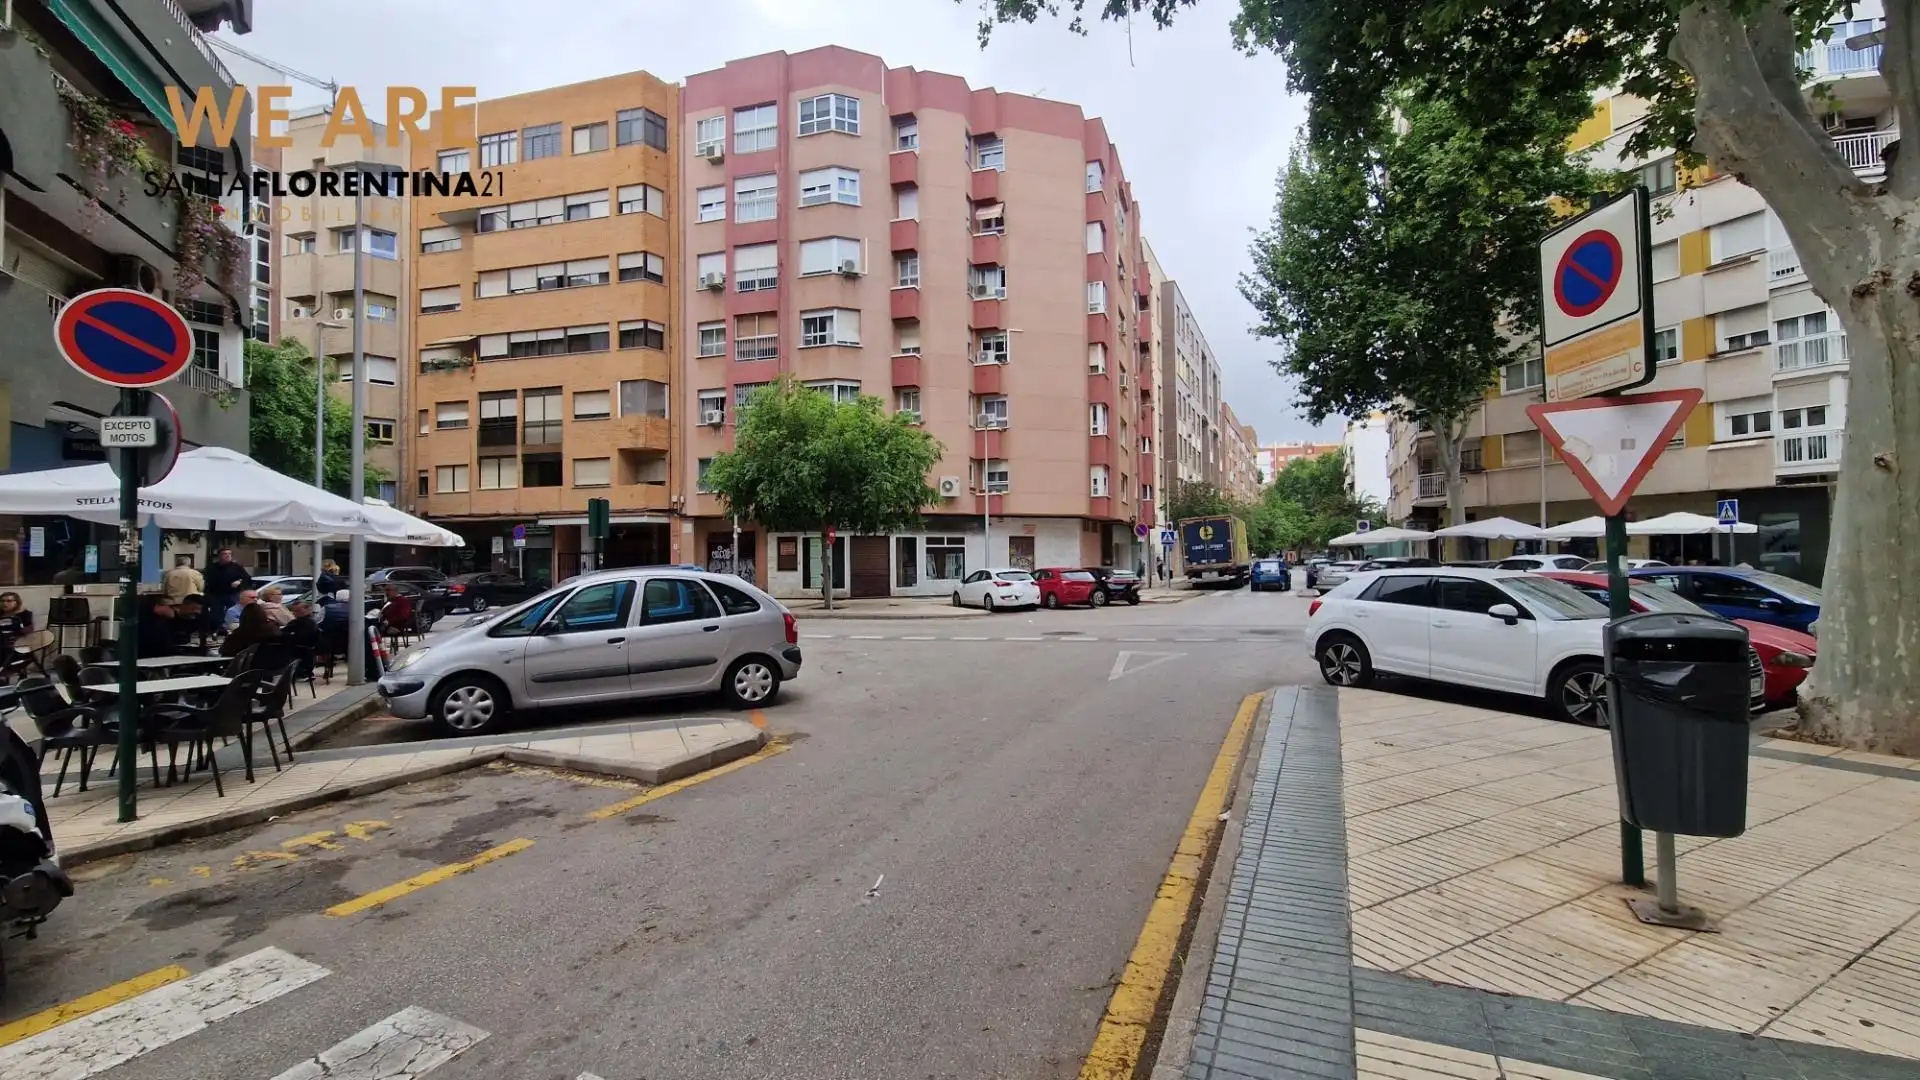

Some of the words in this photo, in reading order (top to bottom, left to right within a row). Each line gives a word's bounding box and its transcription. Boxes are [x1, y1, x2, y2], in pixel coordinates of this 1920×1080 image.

[104, 421, 151, 430] EXCEPTO
[110, 433, 146, 443] MOTOS
[76, 497, 115, 506] STELLA
[137, 498, 173, 510] RTOIS
